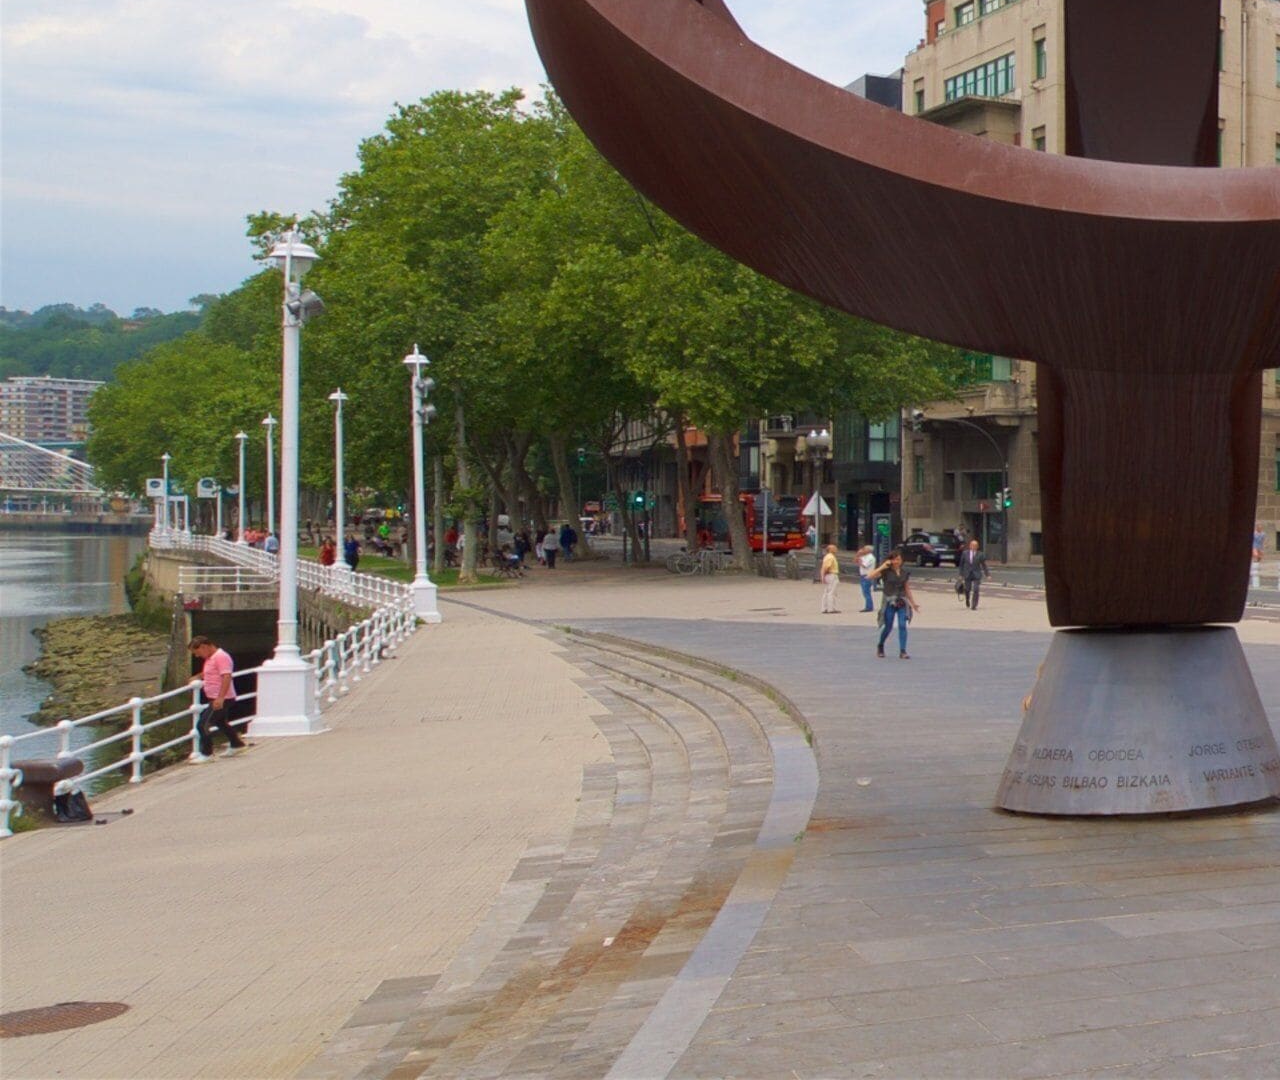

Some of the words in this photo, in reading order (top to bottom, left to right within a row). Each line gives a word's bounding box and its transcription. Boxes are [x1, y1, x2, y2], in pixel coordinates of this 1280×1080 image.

[1188, 742, 1227, 758] JORGE
[1062, 775, 1109, 789] BILBAO
[1116, 774, 1172, 789] BIZKAIA
[1202, 765, 1255, 782] VARIANTE
